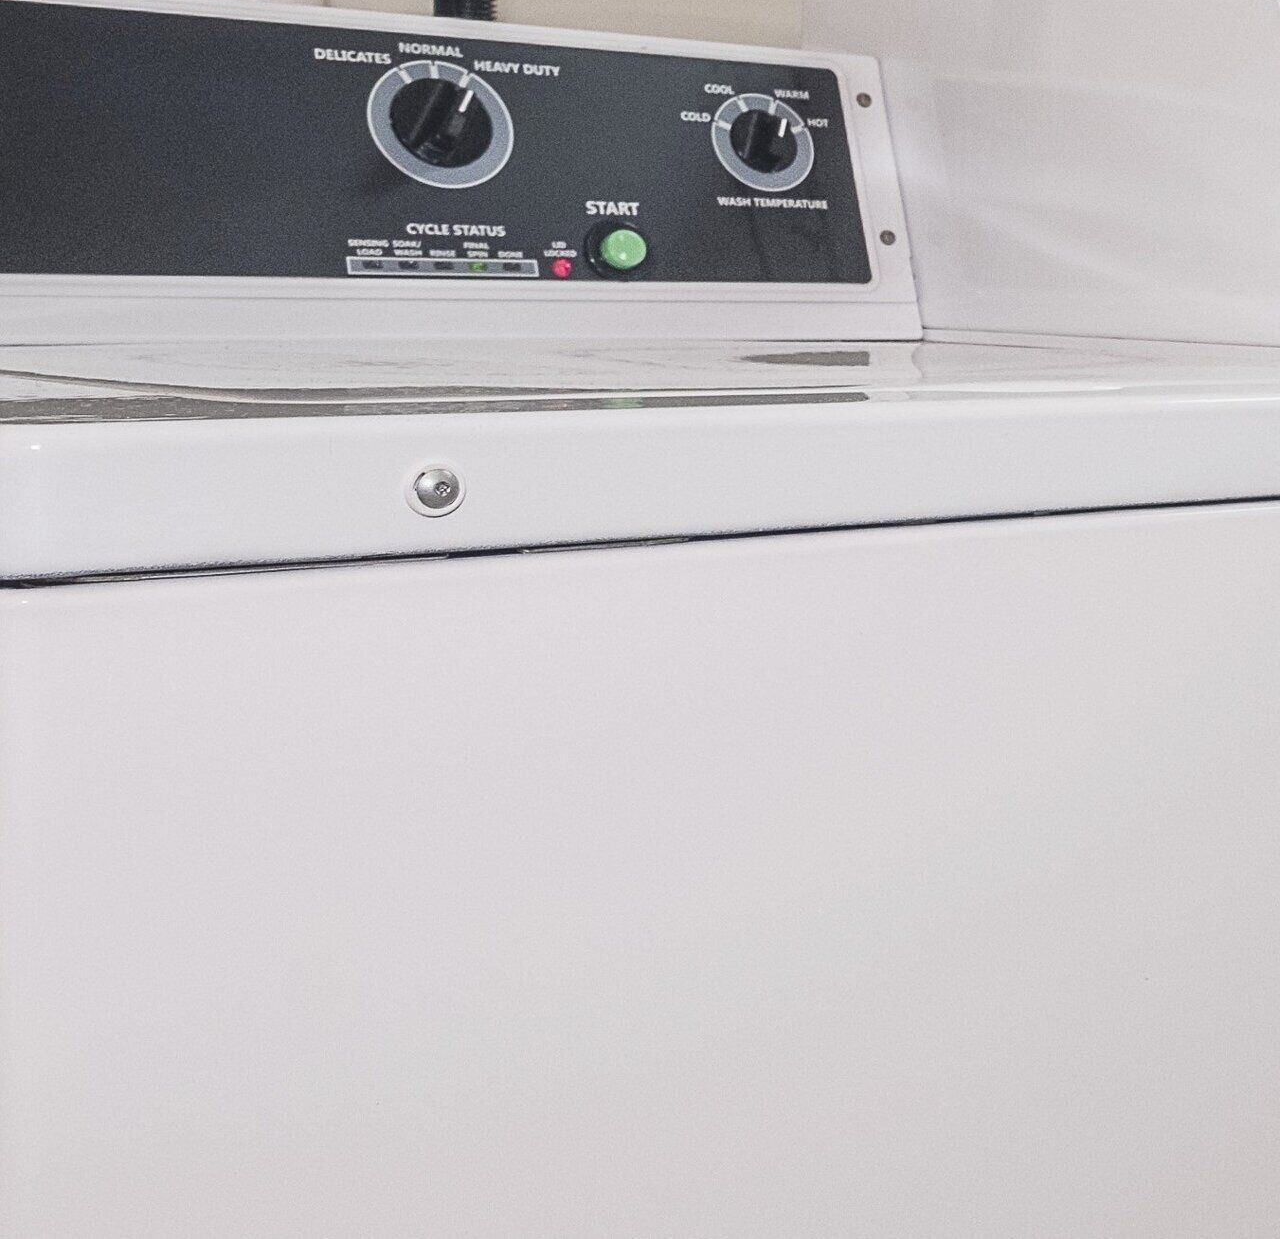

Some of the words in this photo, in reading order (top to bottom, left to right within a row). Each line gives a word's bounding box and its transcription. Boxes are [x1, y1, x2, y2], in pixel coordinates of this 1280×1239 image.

[314, 47, 391, 64] DELICATES
[399, 42, 463, 58] NORMAL
[474, 60, 520, 74] HEAVY
[522, 63, 560, 77] DUTY
[704, 83, 735, 95] COOL
[774, 89, 810, 100] WARM
[680, 111, 712, 122] COLD
[807, 118, 829, 128] HOT
[585, 200, 640, 216] START
[716, 196, 751, 207] WASH
[753, 197, 829, 210] TEMPERATURE
[406, 222, 450, 236] CYCLE
[452, 223, 506, 237] STATUS
